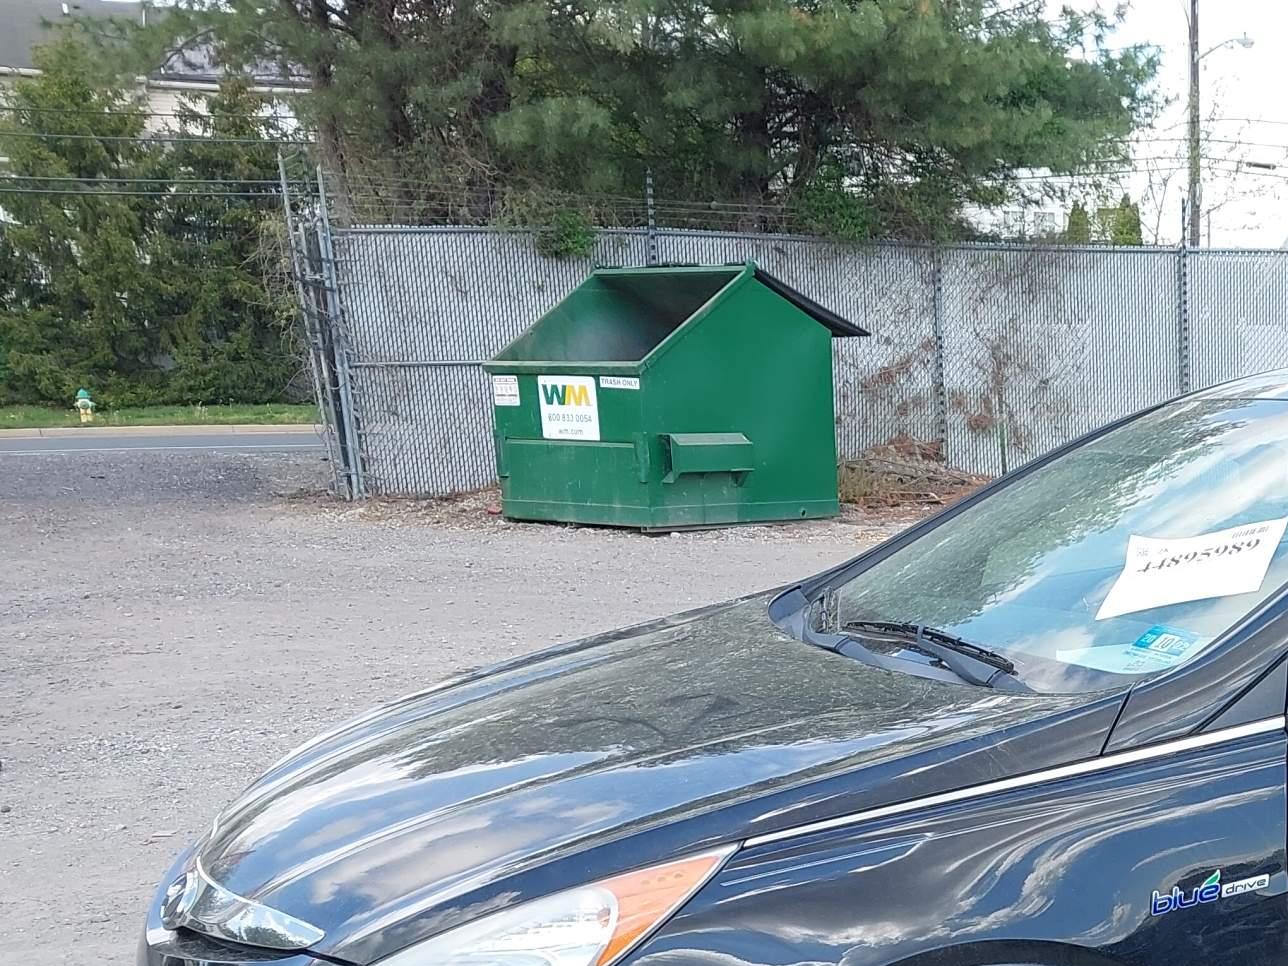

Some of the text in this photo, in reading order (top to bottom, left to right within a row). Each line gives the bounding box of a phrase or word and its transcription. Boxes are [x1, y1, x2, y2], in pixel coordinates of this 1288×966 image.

[541, 384, 590, 406] WM
[1151, 877, 1267, 916] blue drive
